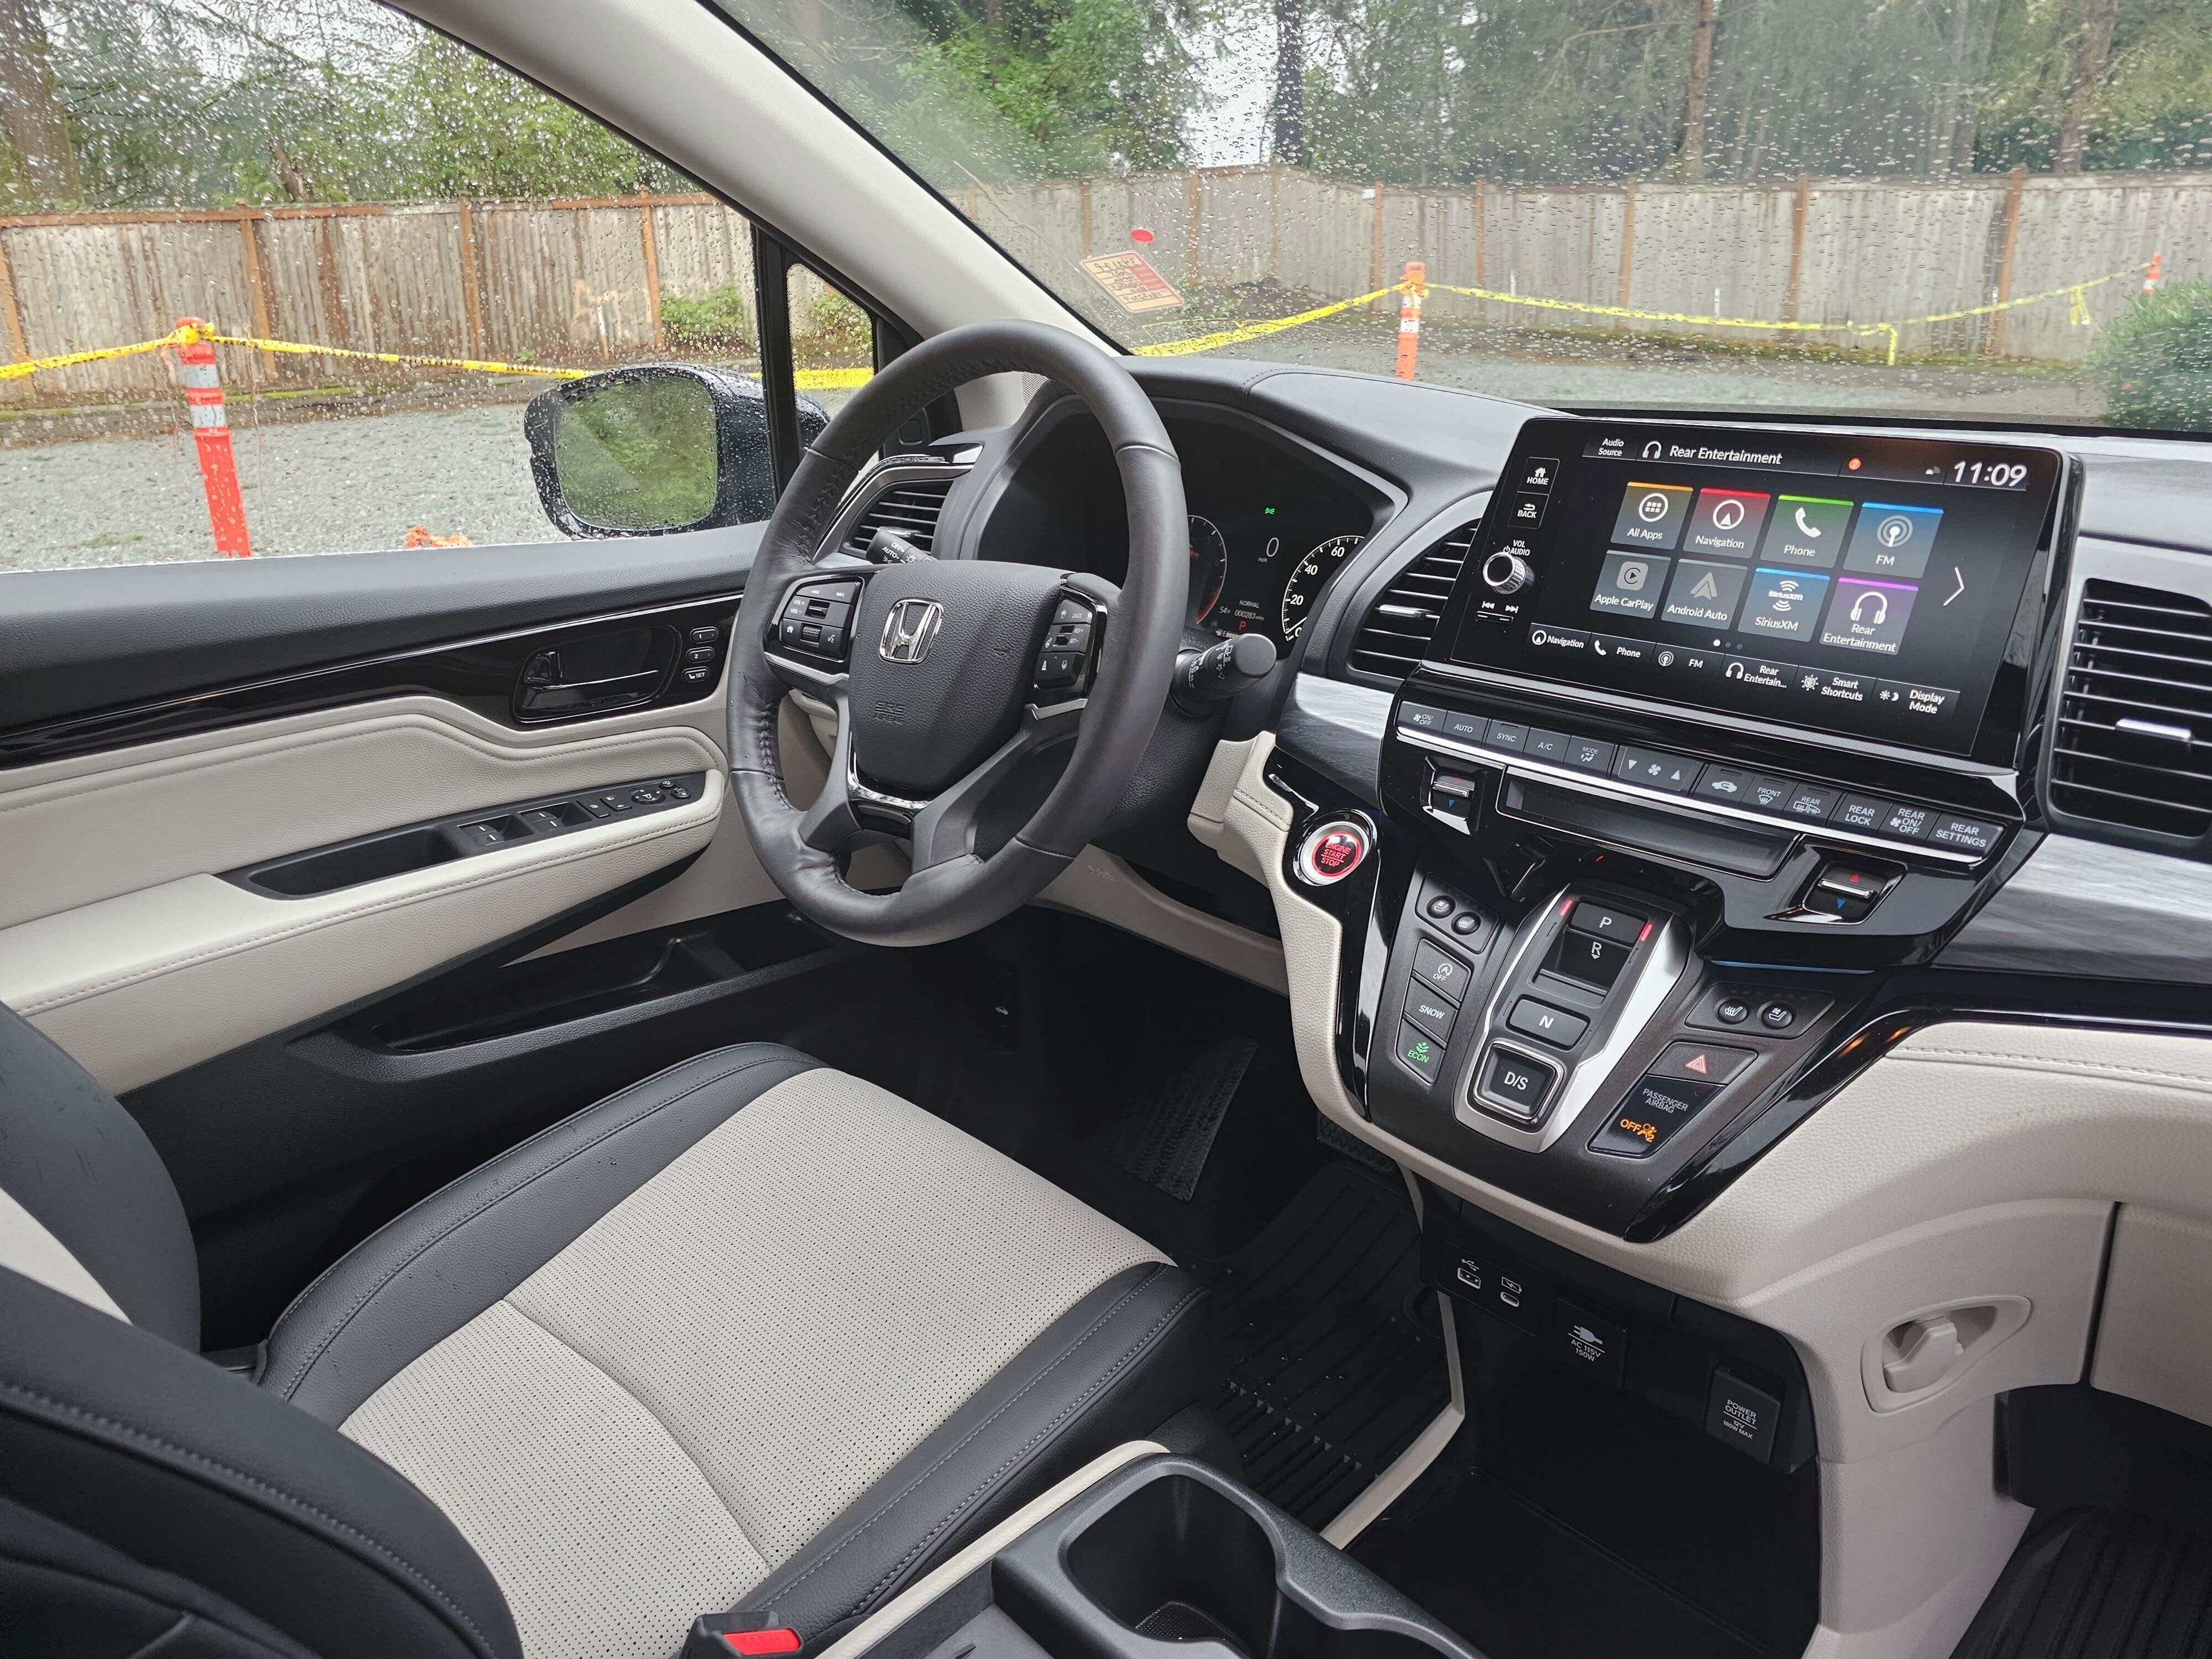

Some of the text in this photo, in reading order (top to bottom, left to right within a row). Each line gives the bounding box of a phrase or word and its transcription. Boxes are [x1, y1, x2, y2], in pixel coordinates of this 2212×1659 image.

[1602, 437, 1624, 447] Audio
[1598, 447, 1622, 457] Source
[1670, 445, 1782, 465] Rear Entertainment
[1953, 461, 2027, 487] 11:09
[1526, 477, 1549, 486] HOME
[1517, 509, 1537, 519] BACK
[1627, 528, 1663, 541] All Apps
[1266, 538, 1279, 557] 0
[1695, 535, 1745, 549] Navigation
[882, 547, 898, 558] AUTO
[1331, 546, 1345, 557] 60
[1510, 547, 1530, 556] AUDIO
[1784, 545, 1815, 557] Phone
[1876, 555, 1895, 566] FM
[1305, 565, 1318, 576] 40
[1239, 600, 1259, 608] NORMAL
[1290, 594, 1303, 606] 20
[1594, 594, 1654, 612] Apple CarPlay
[1667, 603, 1728, 622] Android Auto
[1239, 621, 1246, 630] P
[1755, 617, 1798, 631] SiriusXM
[1851, 623, 1875, 635] Rear
[1547, 635, 1584, 649] Navigation
[1823, 633, 1897, 653] Entertainment
[1616, 647, 1641, 658] Phone
[1688, 659, 1703, 669] FM
[1759, 665, 1779, 676] Rear
[1832, 677, 1859, 688] Smart
[1821, 686, 1863, 702] Shortcuts
[1909, 688, 1945, 705] Display
[1909, 701, 1938, 714] Mode
[1419, 718, 1432, 727] OFF
[1454, 724, 1473, 733] AUTO
[1497, 733, 1516, 743] SYNC
[1538, 742, 1553, 752] A/C
[1757, 787, 1781, 798] FRONT
[1801, 796, 1820, 805] REAR
[1849, 805, 1875, 817] REAR
[1898, 808, 1926, 821] REAR
[1845, 814, 1871, 826] LOCK
[1902, 817, 1922, 827] ON/
[1899, 825, 1919, 836] OFF
[1951, 823, 1979, 836] REAR
[1936, 830, 1986, 848] SETTINGS
[1323, 849, 1346, 860] START
[1326, 842, 1352, 855] ENGINE
[1321, 857, 1340, 867] STOP
[1599, 916, 1612, 928] P
[1592, 942, 1602, 956] R
[1419, 1005, 1445, 1019] SNOW
[1539, 1016, 1554, 1029] N
[1407, 1050, 1429, 1063] ECON
[1504, 1071, 1528, 1091] D/S
[1642, 1088, 1688, 1111] PASSENGER
[1645, 1098, 1674, 1113] AIRBAG
[1620, 1119, 1642, 1132] OFF
[1571, 1339, 1601, 1358] AC 115V
[1575, 1348, 1595, 1361] 150W
[1727, 1399, 1756, 1418] POWER
[1725, 1405, 1756, 1425] OUTLET
[1723, 1421, 1753, 1439] 180W MAX
[1734, 1420, 1745, 1428] 12V
